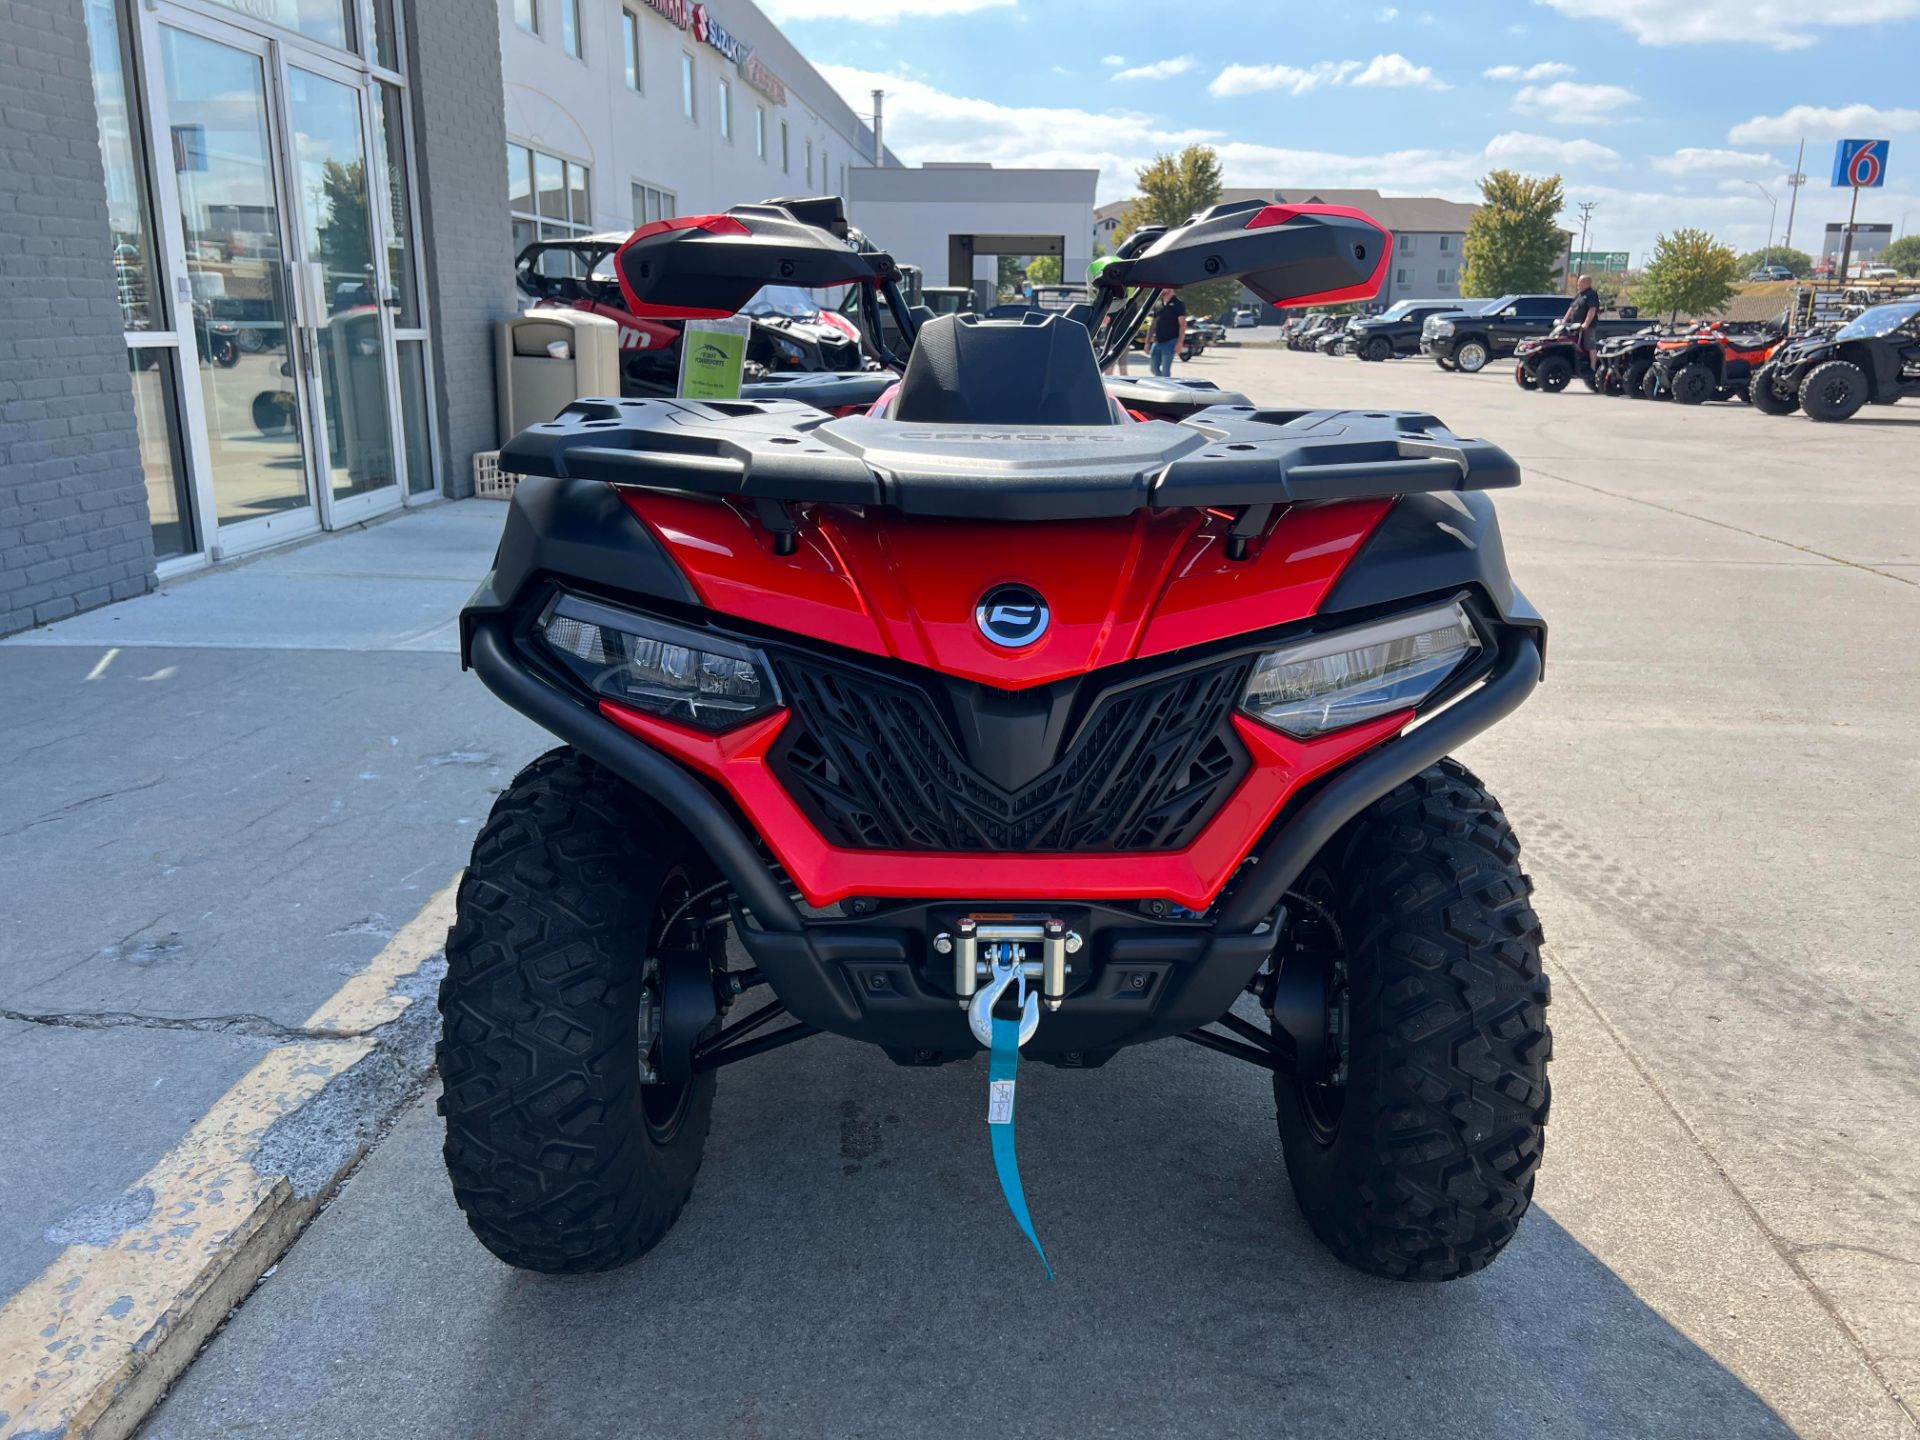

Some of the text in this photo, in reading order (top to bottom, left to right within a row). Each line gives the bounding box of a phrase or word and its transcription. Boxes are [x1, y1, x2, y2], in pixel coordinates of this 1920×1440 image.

[707, 18, 741, 64] SUZUKI
[1847, 141, 1879, 186] 6
[899, 432, 1124, 442] CFMOTO
